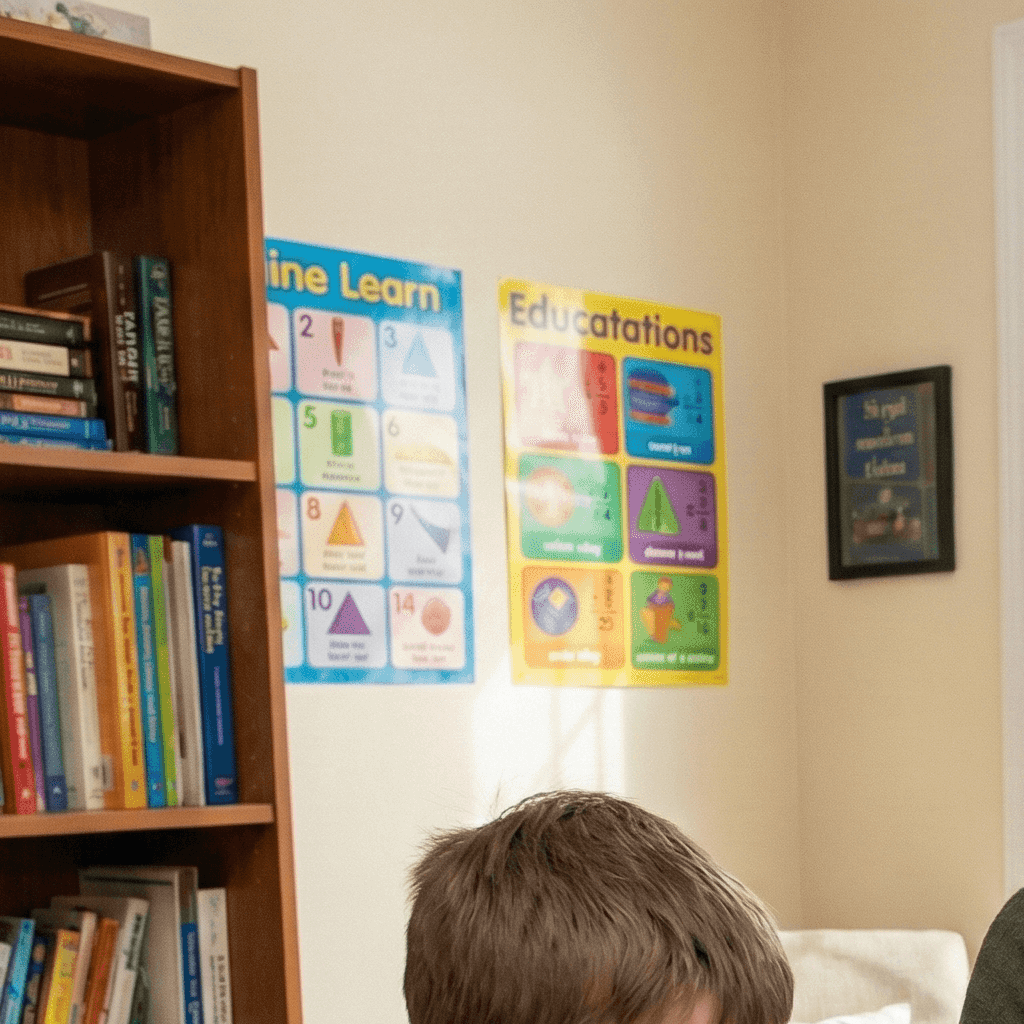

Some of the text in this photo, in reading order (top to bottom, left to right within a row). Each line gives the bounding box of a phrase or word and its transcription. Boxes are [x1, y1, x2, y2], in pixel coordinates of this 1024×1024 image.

[265, 248, 441, 312] ine Learn
[300, 314, 315, 339] 2
[509, 291, 714, 356] Educatations
[383, 325, 398, 349] 3
[303, 404, 318, 430] 5
[387, 415, 400, 438] 6
[306, 496, 322, 522] 8
[390, 502, 404, 526] 9
[308, 586, 333, 611] 10
